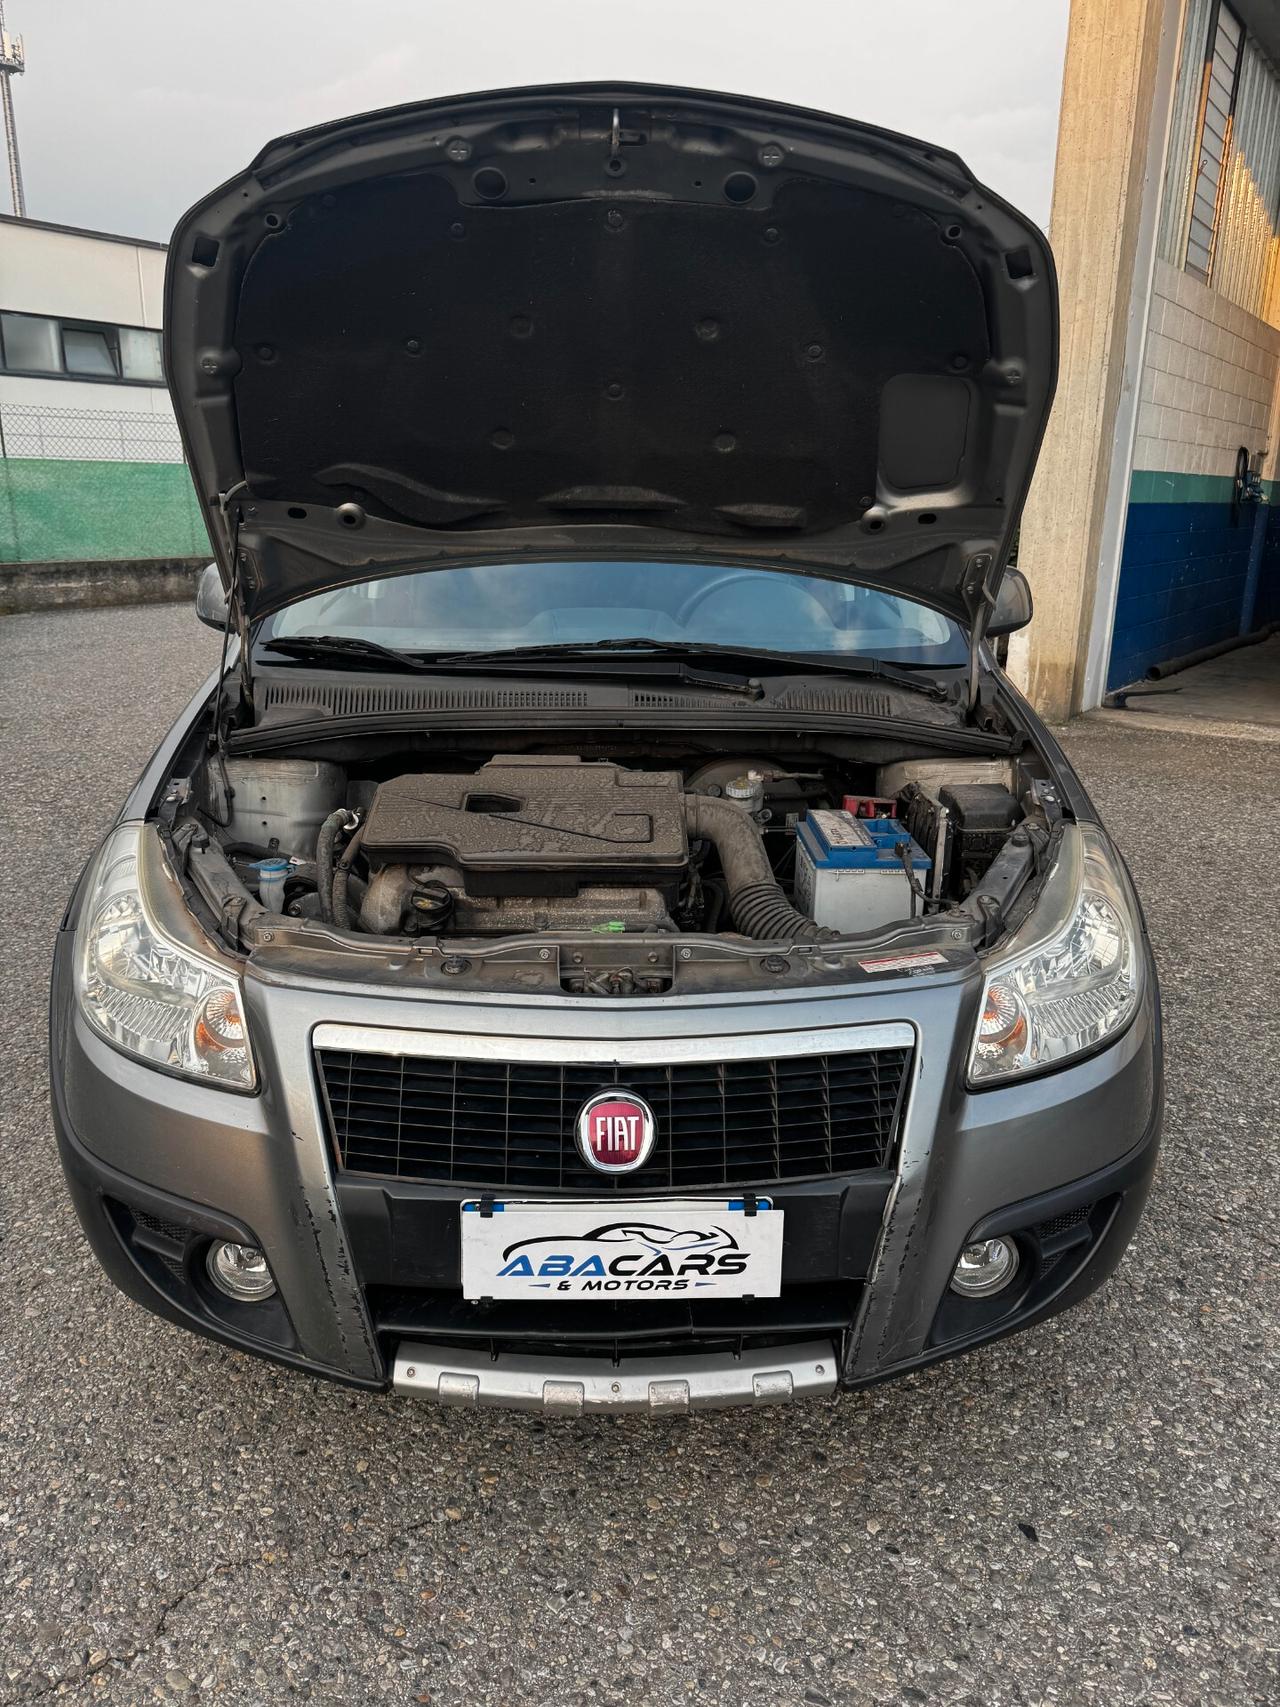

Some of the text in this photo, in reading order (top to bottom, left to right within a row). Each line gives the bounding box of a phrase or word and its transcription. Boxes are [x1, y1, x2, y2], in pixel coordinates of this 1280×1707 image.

[595, 1115, 640, 1151] FIAT
[556, 1279, 690, 1291] & MOTORS
